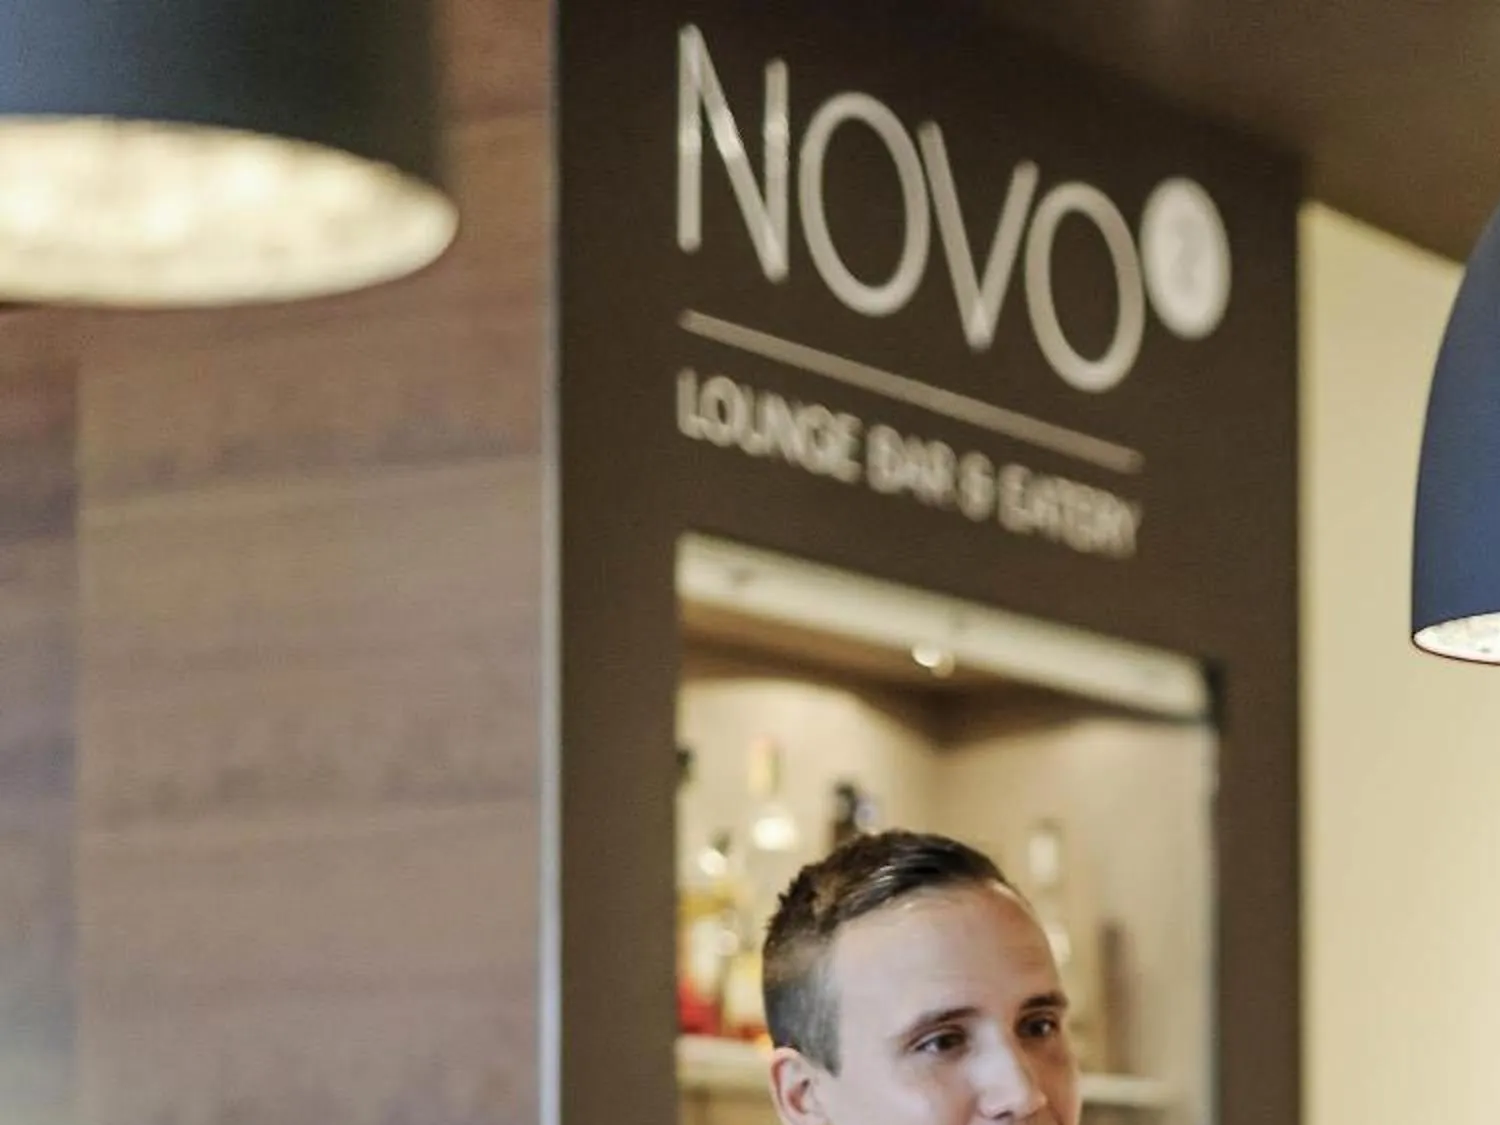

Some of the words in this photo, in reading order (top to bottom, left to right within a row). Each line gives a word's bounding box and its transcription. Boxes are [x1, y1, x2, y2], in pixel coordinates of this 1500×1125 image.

[677, 23, 1144, 393] NOVO
[677, 367, 863, 483] LOUNGE
[866, 424, 957, 505] BAR
